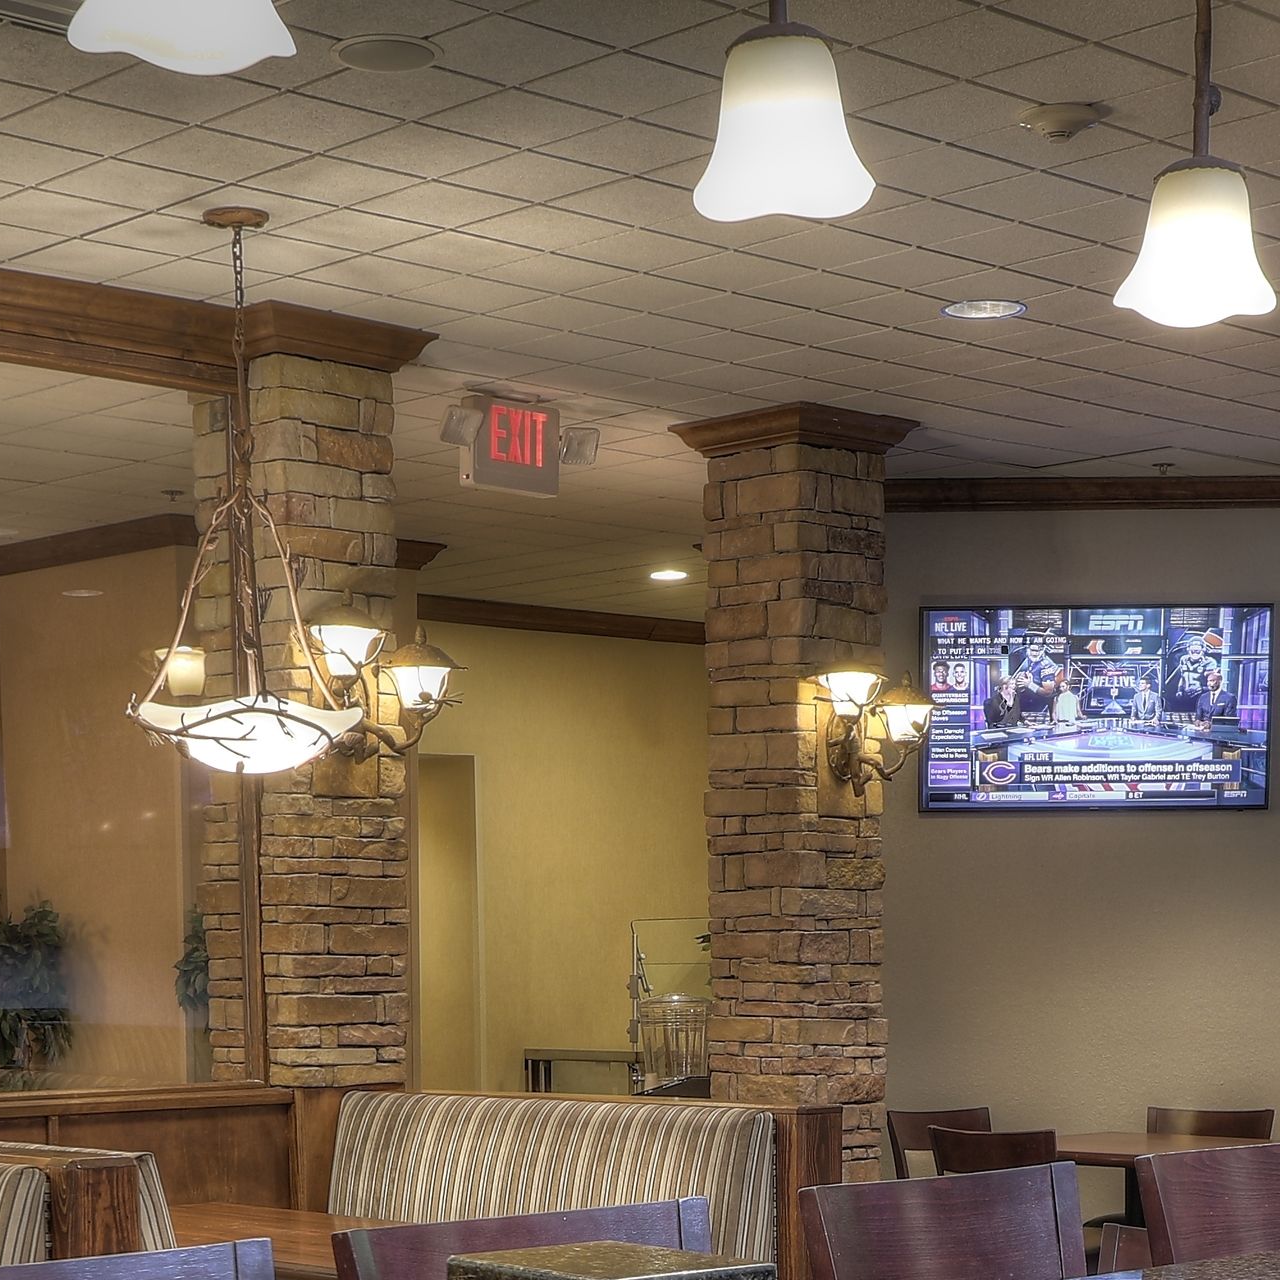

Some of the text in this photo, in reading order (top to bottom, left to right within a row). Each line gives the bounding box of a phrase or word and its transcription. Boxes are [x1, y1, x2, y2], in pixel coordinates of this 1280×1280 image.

[489, 405, 548, 468] EXIT
[935, 622, 967, 632] NFL LIVE
[1089, 615, 1144, 631] ESPN
[970, 637, 991, 645] WANTS
[1092, 676, 1136, 687] NFL LIVE
[1025, 762, 1232, 773] Bears make additions to offense in offseason
[1025, 774, 1040, 782] Sign
[1121, 773, 1141, 782] Taylor
[1192, 773, 1206, 782] Trey
